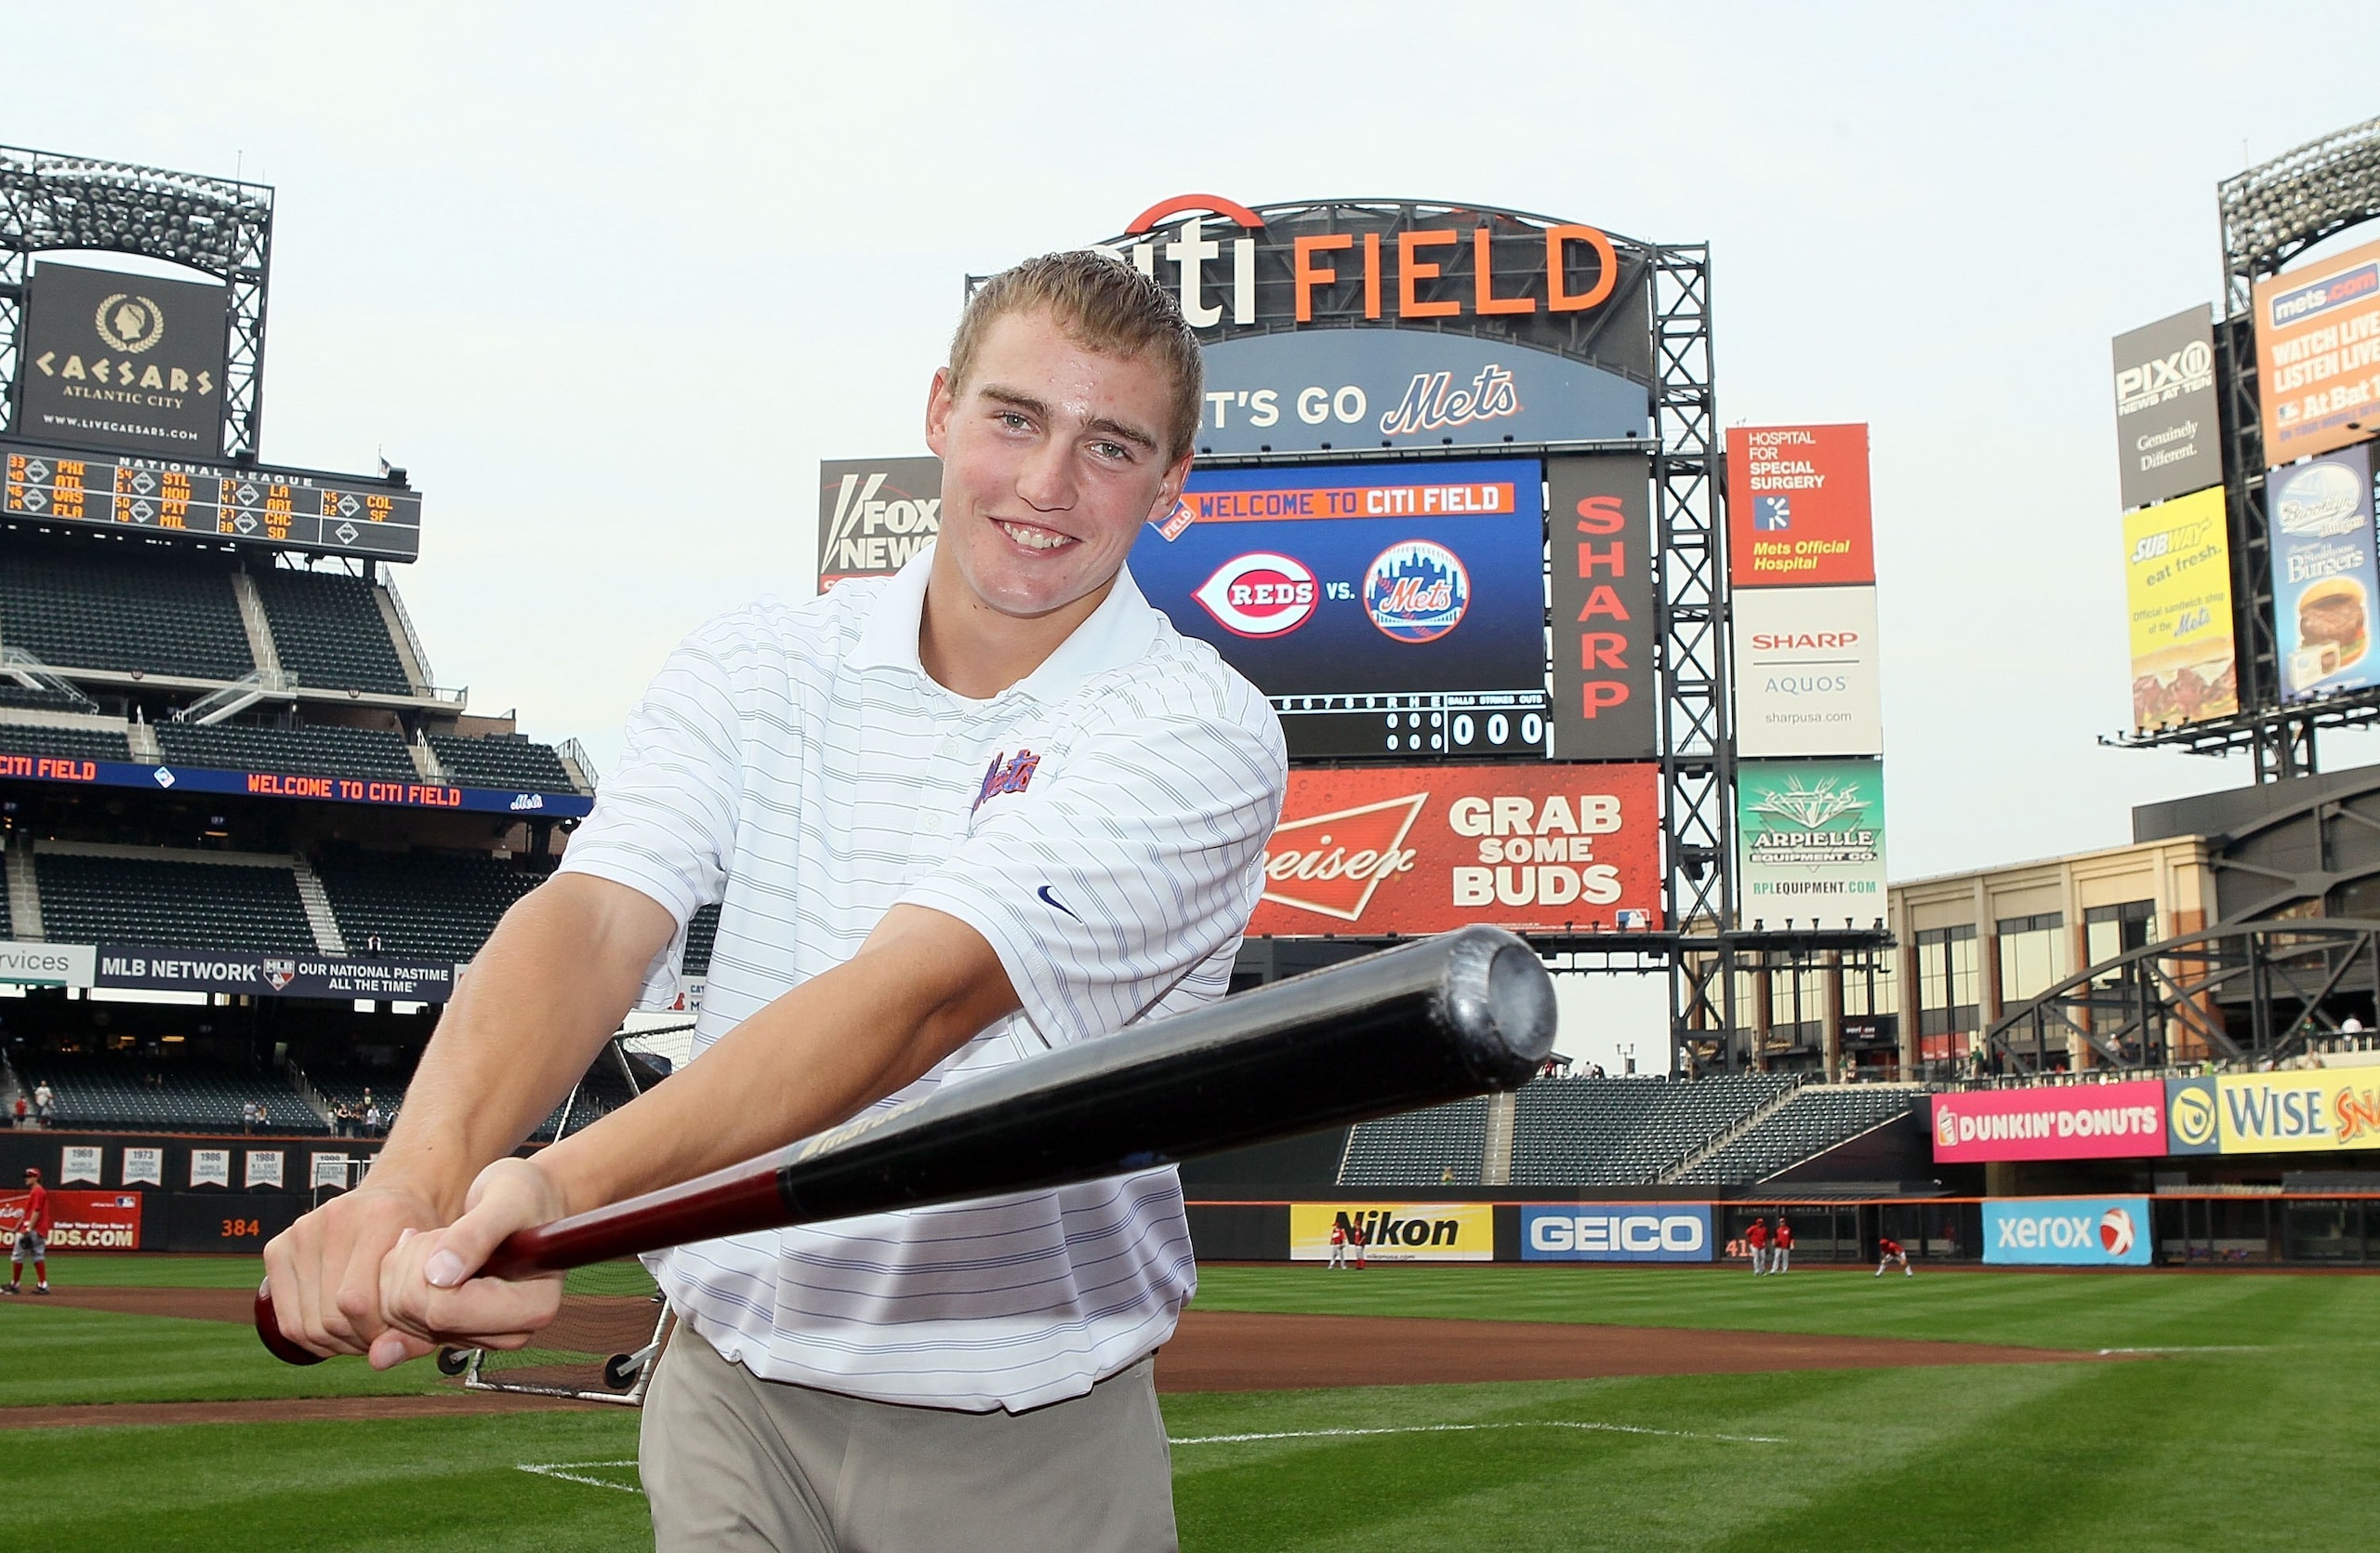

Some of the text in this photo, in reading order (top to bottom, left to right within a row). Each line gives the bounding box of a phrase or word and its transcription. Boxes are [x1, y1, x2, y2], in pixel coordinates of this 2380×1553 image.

[1294, 223, 1619, 323] FIELD
[2275, 272, 2377, 322] mets.com
[2271, 325, 2338, 366] WATCH
[35, 351, 214, 396] CAESARS
[2274, 351, 2338, 393] LISTEN
[62, 385, 184, 409] ATLANTIC CITY
[2162, 385, 2182, 402] AT
[2183, 374, 2212, 394] TEN
[1206, 365, 1523, 435] T'S GO Mets
[2302, 392, 2330, 419] At
[2331, 379, 2371, 410] Bat
[43, 414, 199, 442] WWW.LIVECAESARS.COM
[1749, 431, 1816, 445] HOSPITAL
[2136, 419, 2199, 451] Genuinely
[1749, 447, 1778, 460] FOR
[2140, 443, 2198, 471] Different.
[9, 456, 86, 476] 33 PHI
[119, 456, 313, 487] NATIONAL LEAGUE
[1750, 461, 1815, 475] SPECIAL
[55, 475, 85, 490] ATL
[163, 472, 192, 487] STL
[1751, 475, 1825, 490] SURGERY
[161, 486, 191, 501] HOU
[269, 484, 290, 498] LA
[52, 503, 84, 518] FLA
[162, 501, 188, 515] PIT
[266, 498, 292, 513] ARI
[366, 494, 394, 511] COL
[1199, 486, 1500, 518] WELCOME TO CITI FIELD
[159, 514, 187, 529] MIL
[264, 511, 293, 527] CHC
[369, 509, 389, 523] SF
[863, 498, 942, 535] FOX
[1163, 511, 1192, 538] FIELD
[267, 526, 287, 540] SD
[2131, 516, 2212, 564] SUBWAY
[1753, 539, 1850, 555] Mets Official
[1753, 556, 1818, 572] Hospital
[2146, 545, 2223, 587] eat fresh.
[2288, 550, 2364, 583] Burgers
[1231, 583, 1313, 605] REDS
[1379, 577, 1453, 614] Mets
[1575, 495, 1631, 721] SHARP
[2133, 592, 2226, 622] Official sandwich shop
[2159, 622, 2172, 631] the
[2174, 606, 2211, 637] Mets
[1752, 632, 1858, 649] SHARP
[1765, 676, 1846, 696] AQUOS
[1324, 697, 1333, 710] 7
[1387, 696, 1398, 708] R
[1408, 696, 1420, 708] H
[1431, 696, 1441, 707] E
[1448, 694, 1543, 706] BALLS STRIKES OUTS
[1386, 711, 1442, 729] 0 0 0
[1765, 712, 1852, 725] sharpusa.com
[1452, 712, 1543, 746] 0 0 0
[1386, 733, 1442, 750] 0 0 0
[37, 759, 97, 780] FIELD
[247, 774, 462, 806] WELCOME TO CITI FIELD
[510, 793, 543, 811] Mets
[1449, 796, 1622, 836] GRAB
[1753, 830, 1875, 848] ARPIELLE
[1263, 834, 1417, 882] eiser
[1478, 837, 1593, 864] SOME
[1750, 853, 1877, 862] EQUIPMENT CO.
[1452, 865, 1622, 907] BUDS
[1753, 881, 1876, 896] RPLEQUIPMENT.COM
[0, 949, 69, 972] rvices
[101, 957, 257, 982] MLB NETWORK
[298, 962, 449, 981] OUR NATIONAL PASTIME
[328, 978, 379, 991] ALL THE
[2225, 1086, 2325, 1136] WISE
[1960, 1105, 2158, 1141] DUNKIN' DONUTS
[73, 1149, 93, 1158] 1969
[134, 1150, 153, 1160] 1973
[201, 1153, 221, 1161] 1986
[222, 1220, 260, 1237] 384
[1334, 1210, 1459, 1247] Nikon
[1529, 1216, 1704, 1252] GEICO
[1998, 1215, 2094, 1249] xerox
[1726, 1239, 1754, 1257] 41
